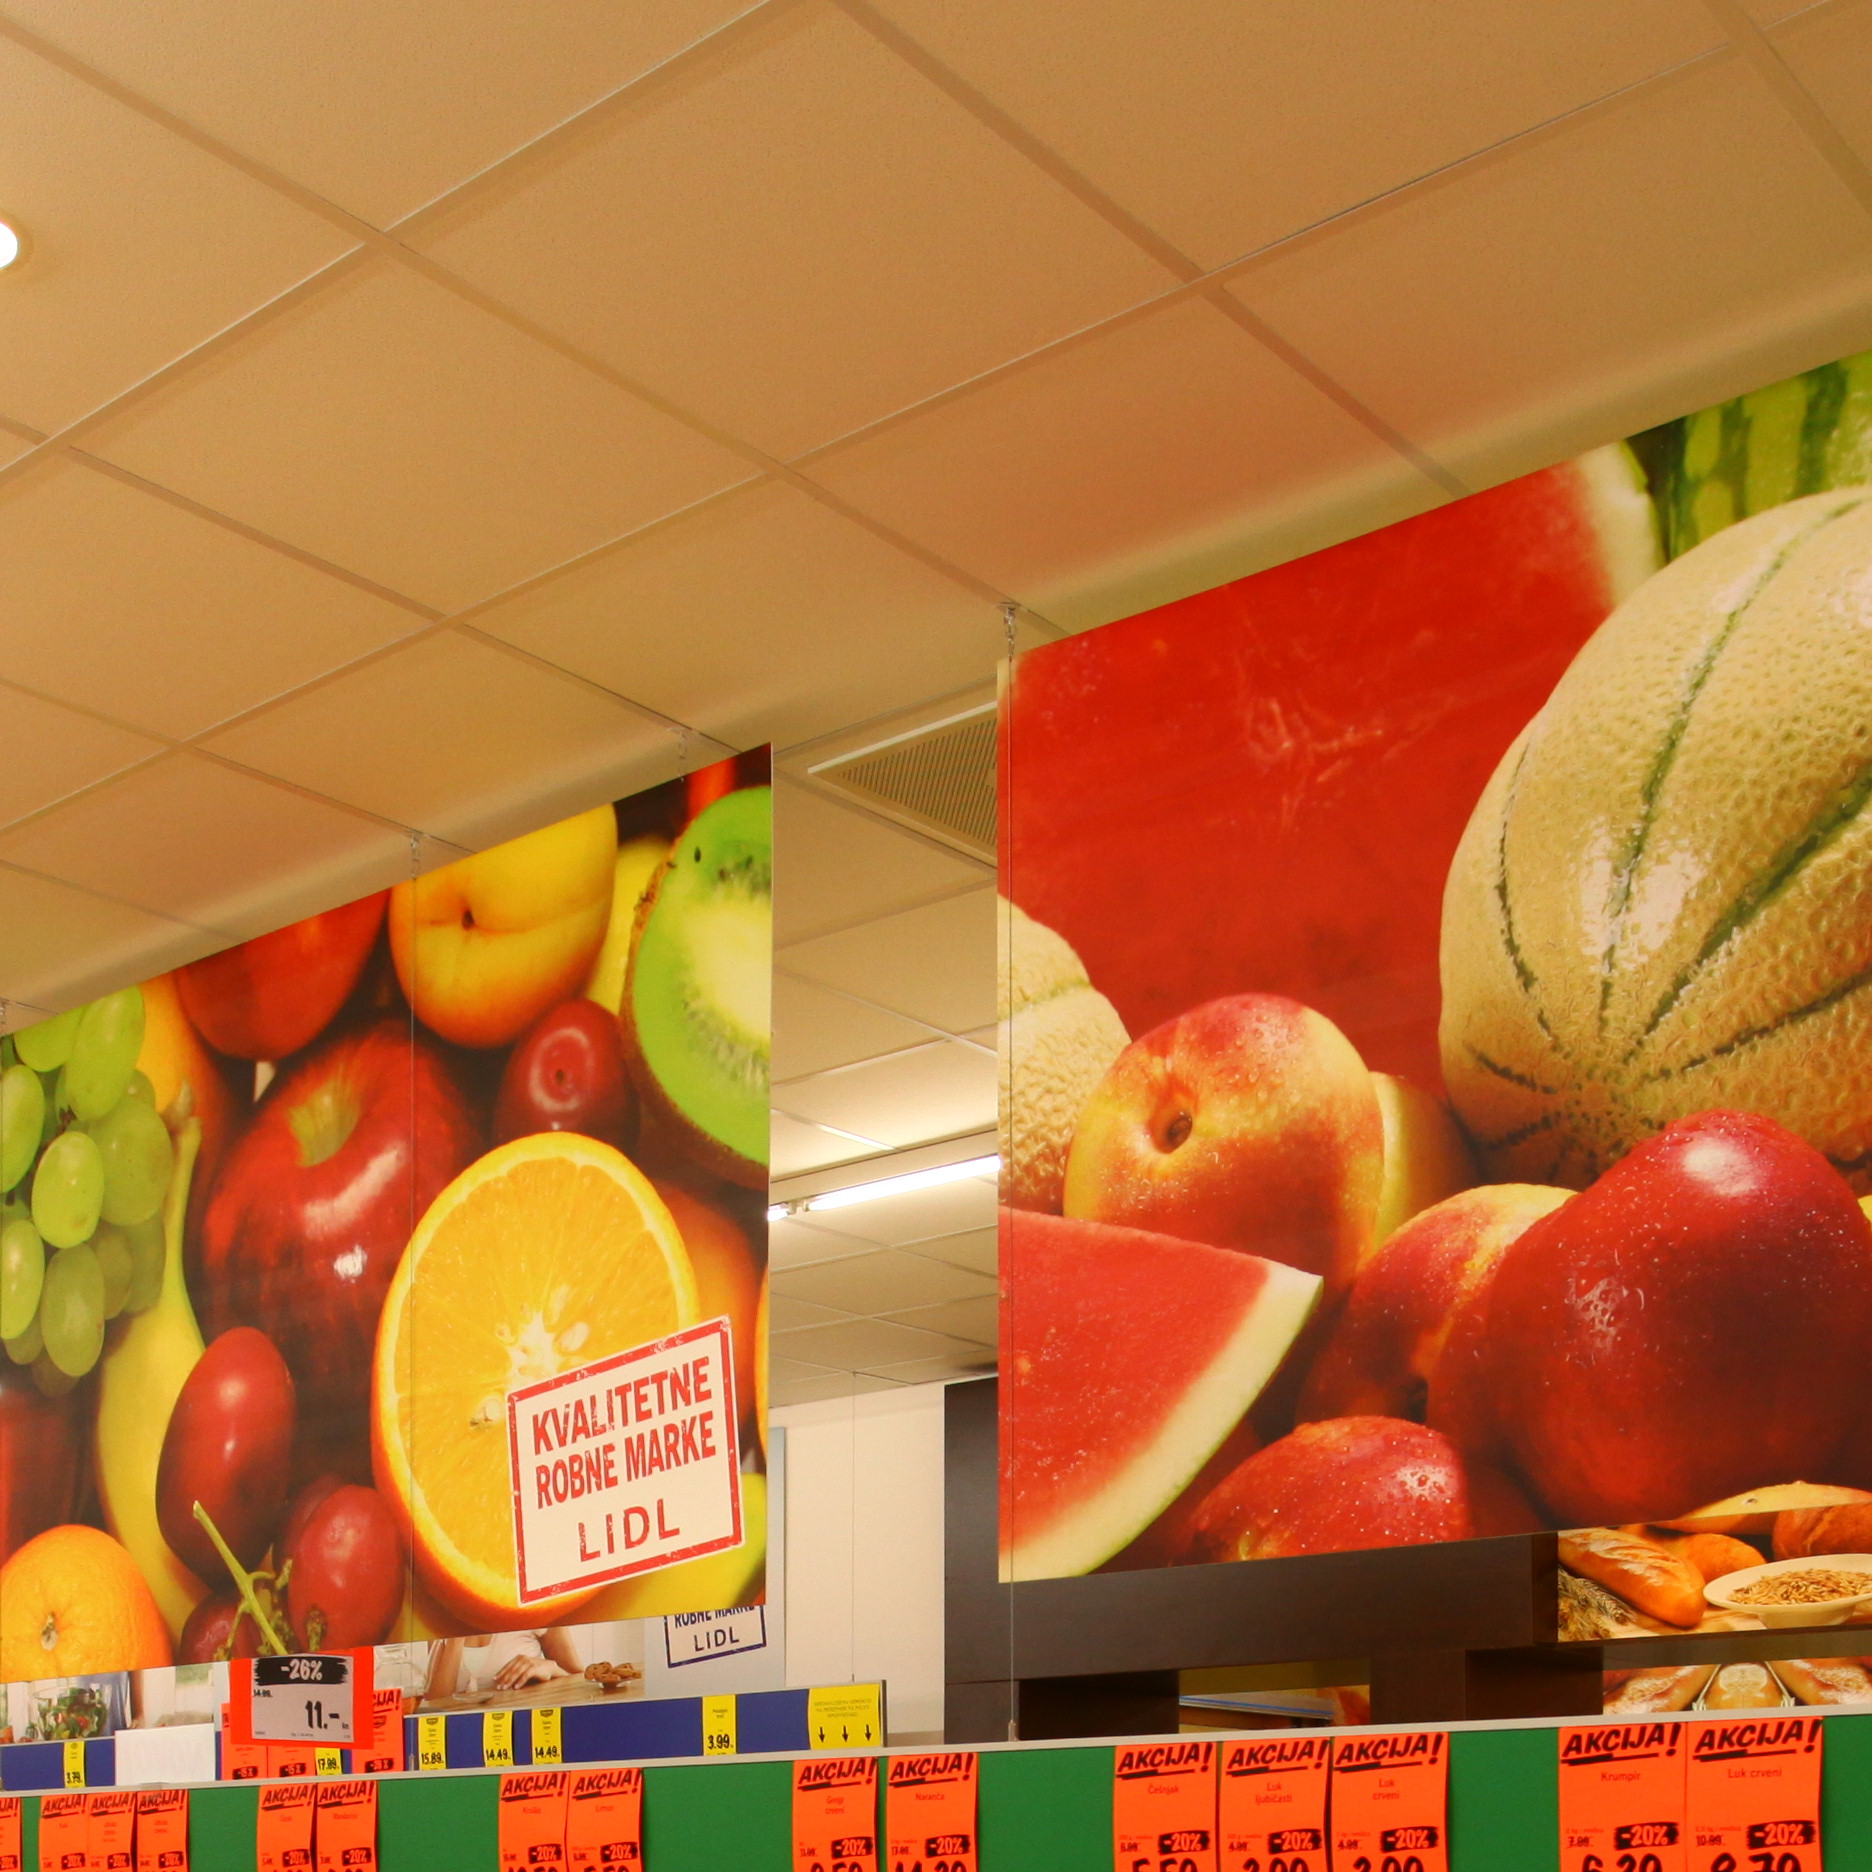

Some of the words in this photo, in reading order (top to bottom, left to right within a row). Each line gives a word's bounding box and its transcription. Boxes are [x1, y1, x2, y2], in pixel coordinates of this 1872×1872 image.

[532, 1357, 712, 1455] KVALITETNE
[536, 1443, 618, 1509] ROBNE
[624, 1411, 716, 1482] MARKE
[579, 1499, 680, 1562] LIDL
[694, 1626, 739, 1652] LIDL
[280, 1659, 323, 1680] -26%
[707, 1734, 729, 1749] 3.99
[1563, 1724, 1681, 1757] AKCIJA!
[1695, 1719, 1822, 1753] AKCIJA!
[1118, 1743, 1213, 1772] AKCIJA!
[1228, 1739, 1327, 1769] AKCIJA!
[799, 1756, 876, 1784] AKCIJA!
[890, 1752, 973, 1780] AKCIJA!
[1601, 1772, 1640, 1783] Krumpir
[1728, 1768, 1747, 1778] Luk
[1750, 1767, 1782, 1778] crveni
[319, 1782, 374, 1802] AKCIJA!
[502, 1772, 567, 1796] AKCIJA!
[573, 1769, 641, 1793] AKCIJA!
[1267, 1782, 1282, 1792] Luk
[43, 1795, 86, 1814] AKCIJA!
[139, 1790, 184, 1810] AKCIJA!
[263, 1784, 317, 1806] AKCIJA!
[1274, 1832, 1313, 1850] -20%
[1621, 1825, 1668, 1846] -20%
[604, 1845, 632, 1859] -20%
